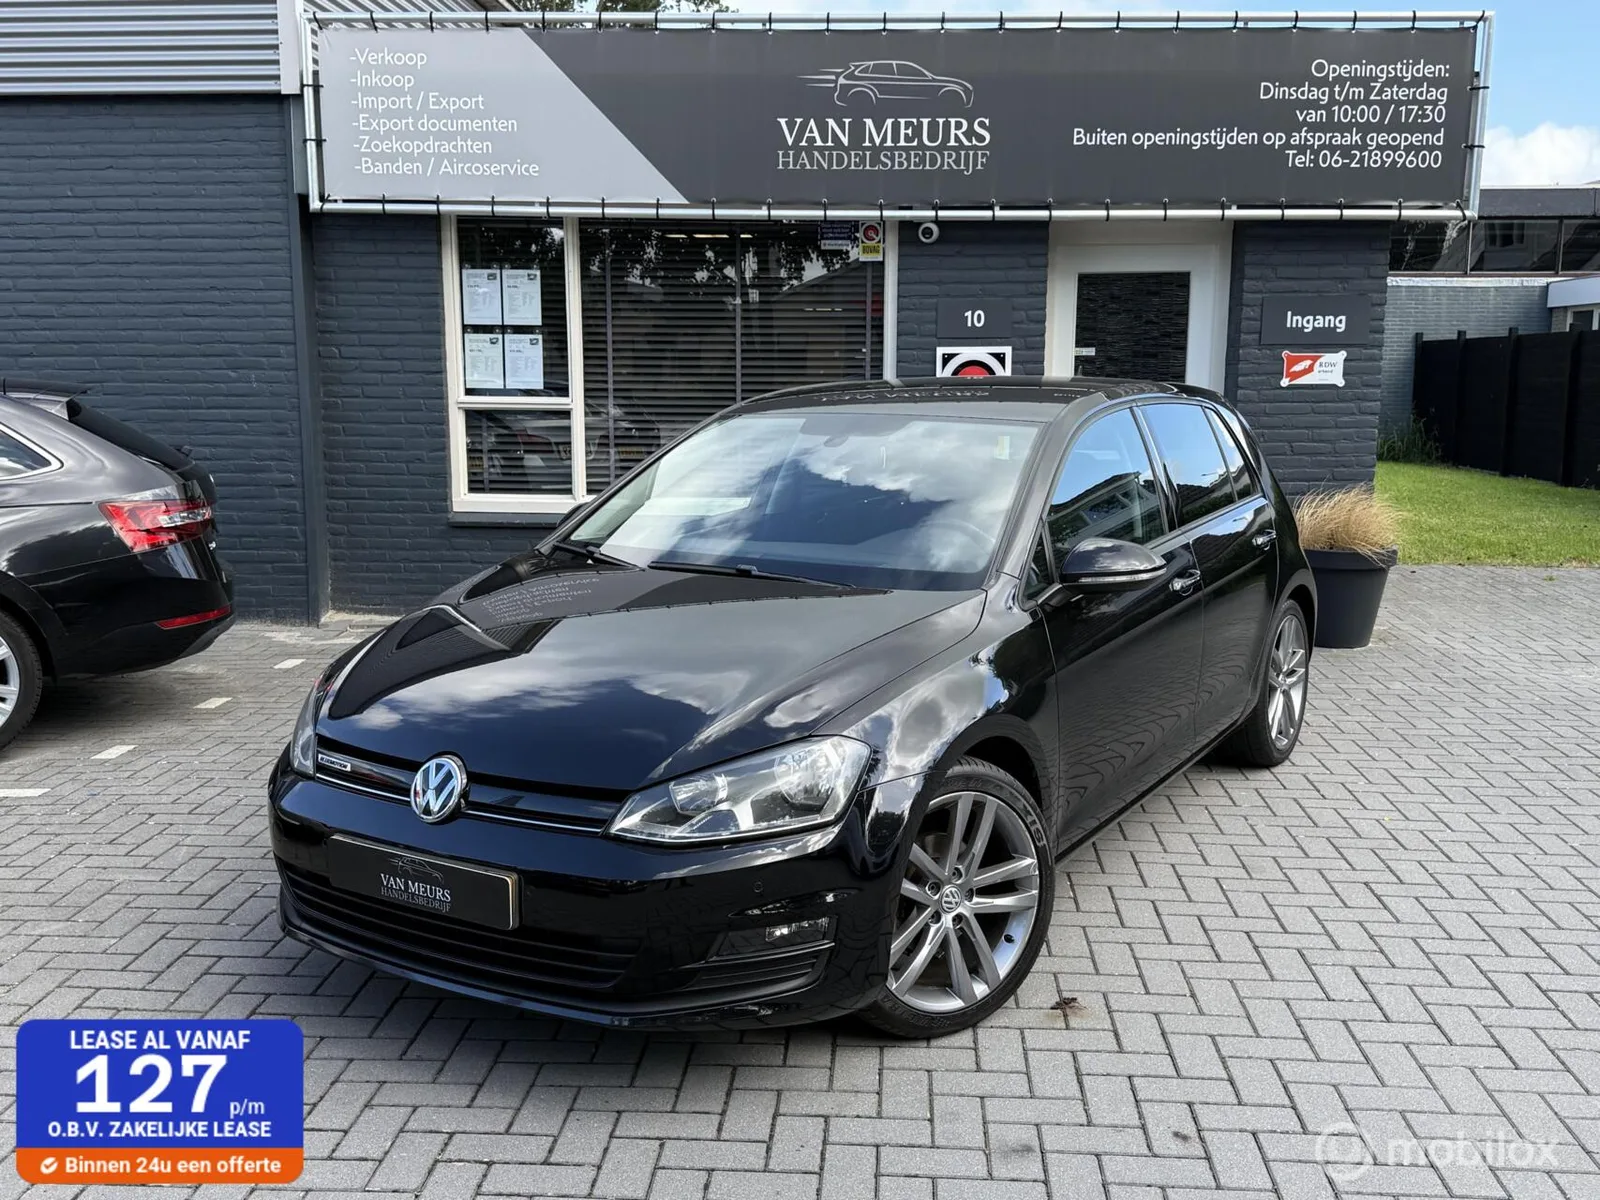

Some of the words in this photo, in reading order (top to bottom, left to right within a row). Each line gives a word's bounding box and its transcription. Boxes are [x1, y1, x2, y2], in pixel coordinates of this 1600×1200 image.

[350, 47, 427, 69] -Verkoop
[350, 70, 414, 91] -Inkoop
[1311, 59, 1450, 81] Openingstijden:
[351, 92, 413, 112] -Import
[416, 91, 424, 111] /
[428, 93, 485, 113] Export
[1260, 82, 1329, 104] Dinsdag
[1333, 81, 1364, 101] t/m
[1369, 82, 1448, 104] Zaterdag
[352, 114, 414, 134] -Export
[418, 114, 518, 132] documenten
[1296, 110, 1326, 122] van
[1331, 105, 1381, 123] 10:00
[1384, 104, 1395, 124] /
[1399, 105, 1446, 123] 17:30
[776, 117, 852, 147] VAN
[862, 117, 991, 147] MEURS
[1073, 128, 1127, 145] Buiten
[1131, 127, 1258, 149] openingstijden
[1262, 132, 1286, 149] op
[1290, 127, 1362, 149] afspraak
[1366, 128, 1444, 149] geopend
[353, 135, 493, 156] -Zoekopdrachten
[354, 157, 423, 175] -Banden
[427, 157, 434, 176] /
[439, 158, 540, 176] Aircoservice
[776, 150, 990, 175] HANDELSBEDRIJF
[1285, 150, 1314, 168] Tel:
[1318, 150, 1443, 168] 06-21899600
[964, 309, 986, 328] 10
[1286, 310, 1346, 332] Ingang
[380, 873, 405, 889] VAN
[408, 880, 451, 903] MEURS
